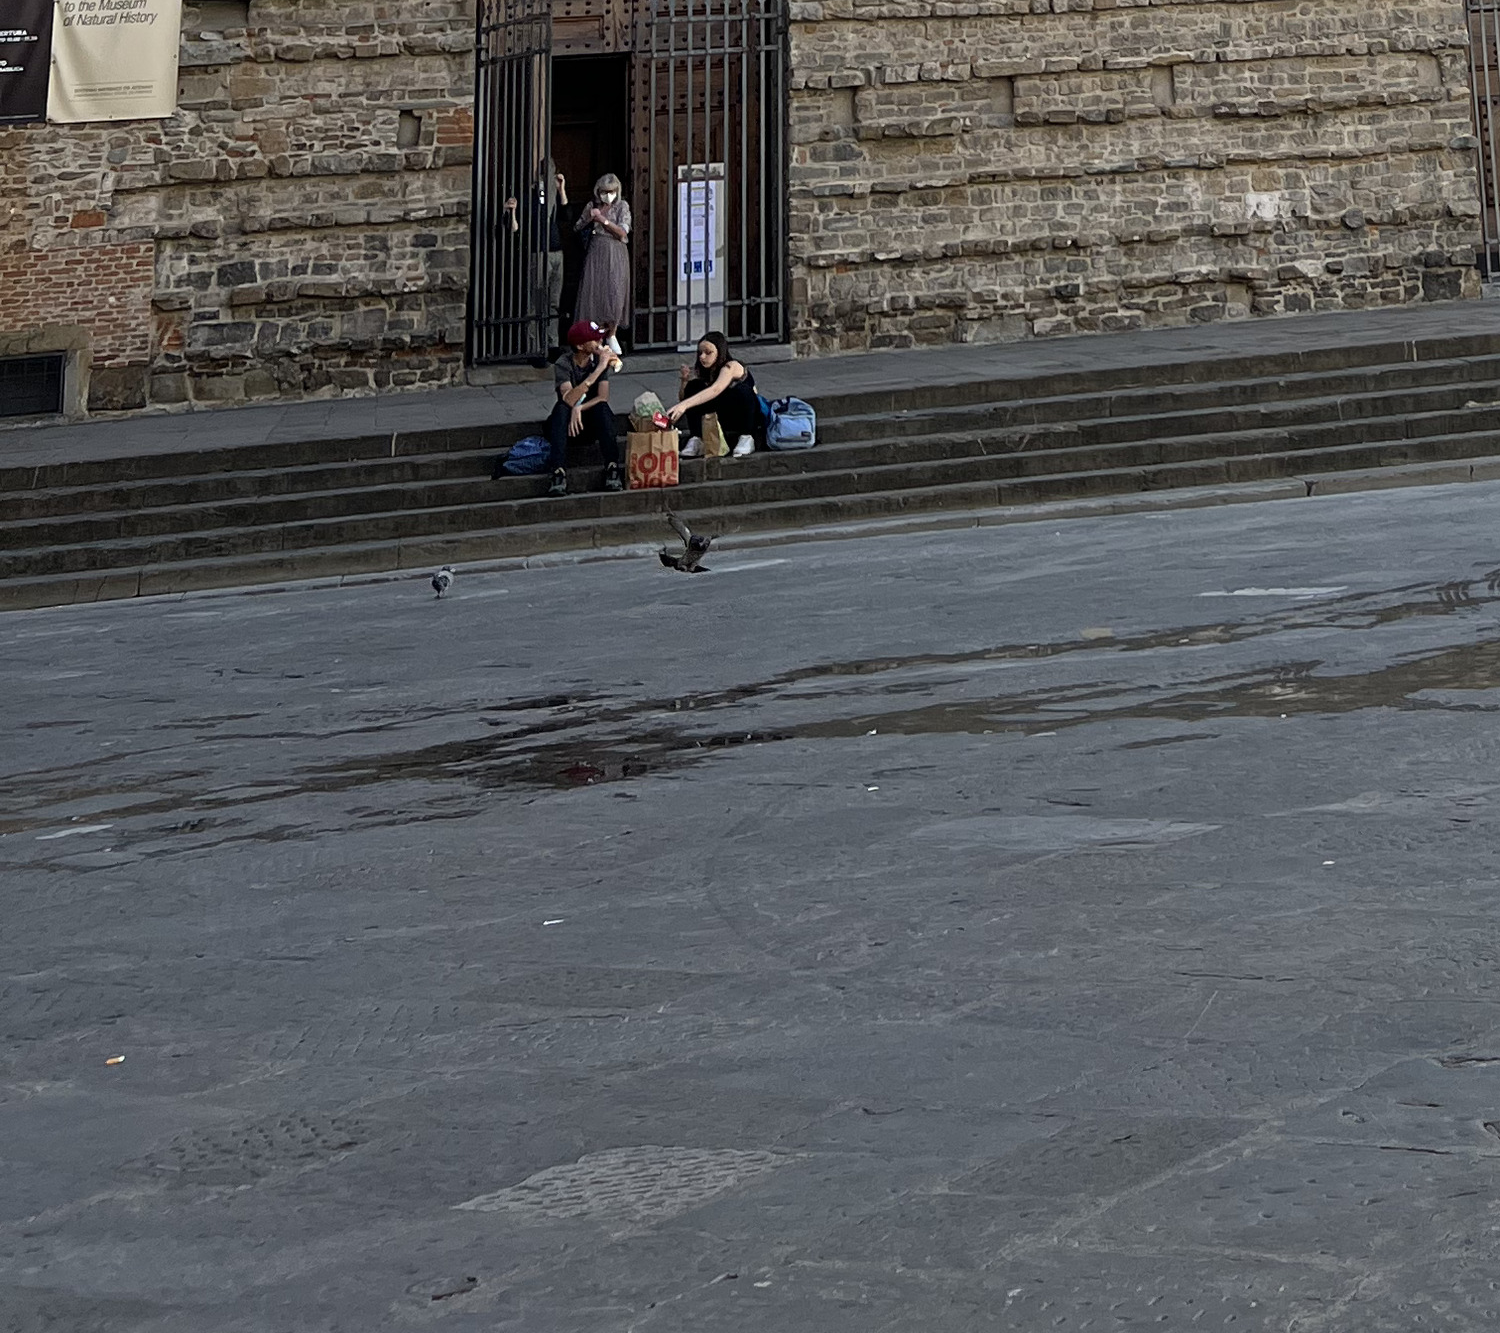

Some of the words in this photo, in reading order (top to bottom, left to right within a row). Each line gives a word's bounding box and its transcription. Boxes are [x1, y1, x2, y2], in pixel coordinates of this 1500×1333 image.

[64, 1, 75, 13] to
[78, 0, 96, 12] the
[63, 14, 75, 27] of
[76, 12, 117, 26] Natural
[119, 11, 158, 25] History
